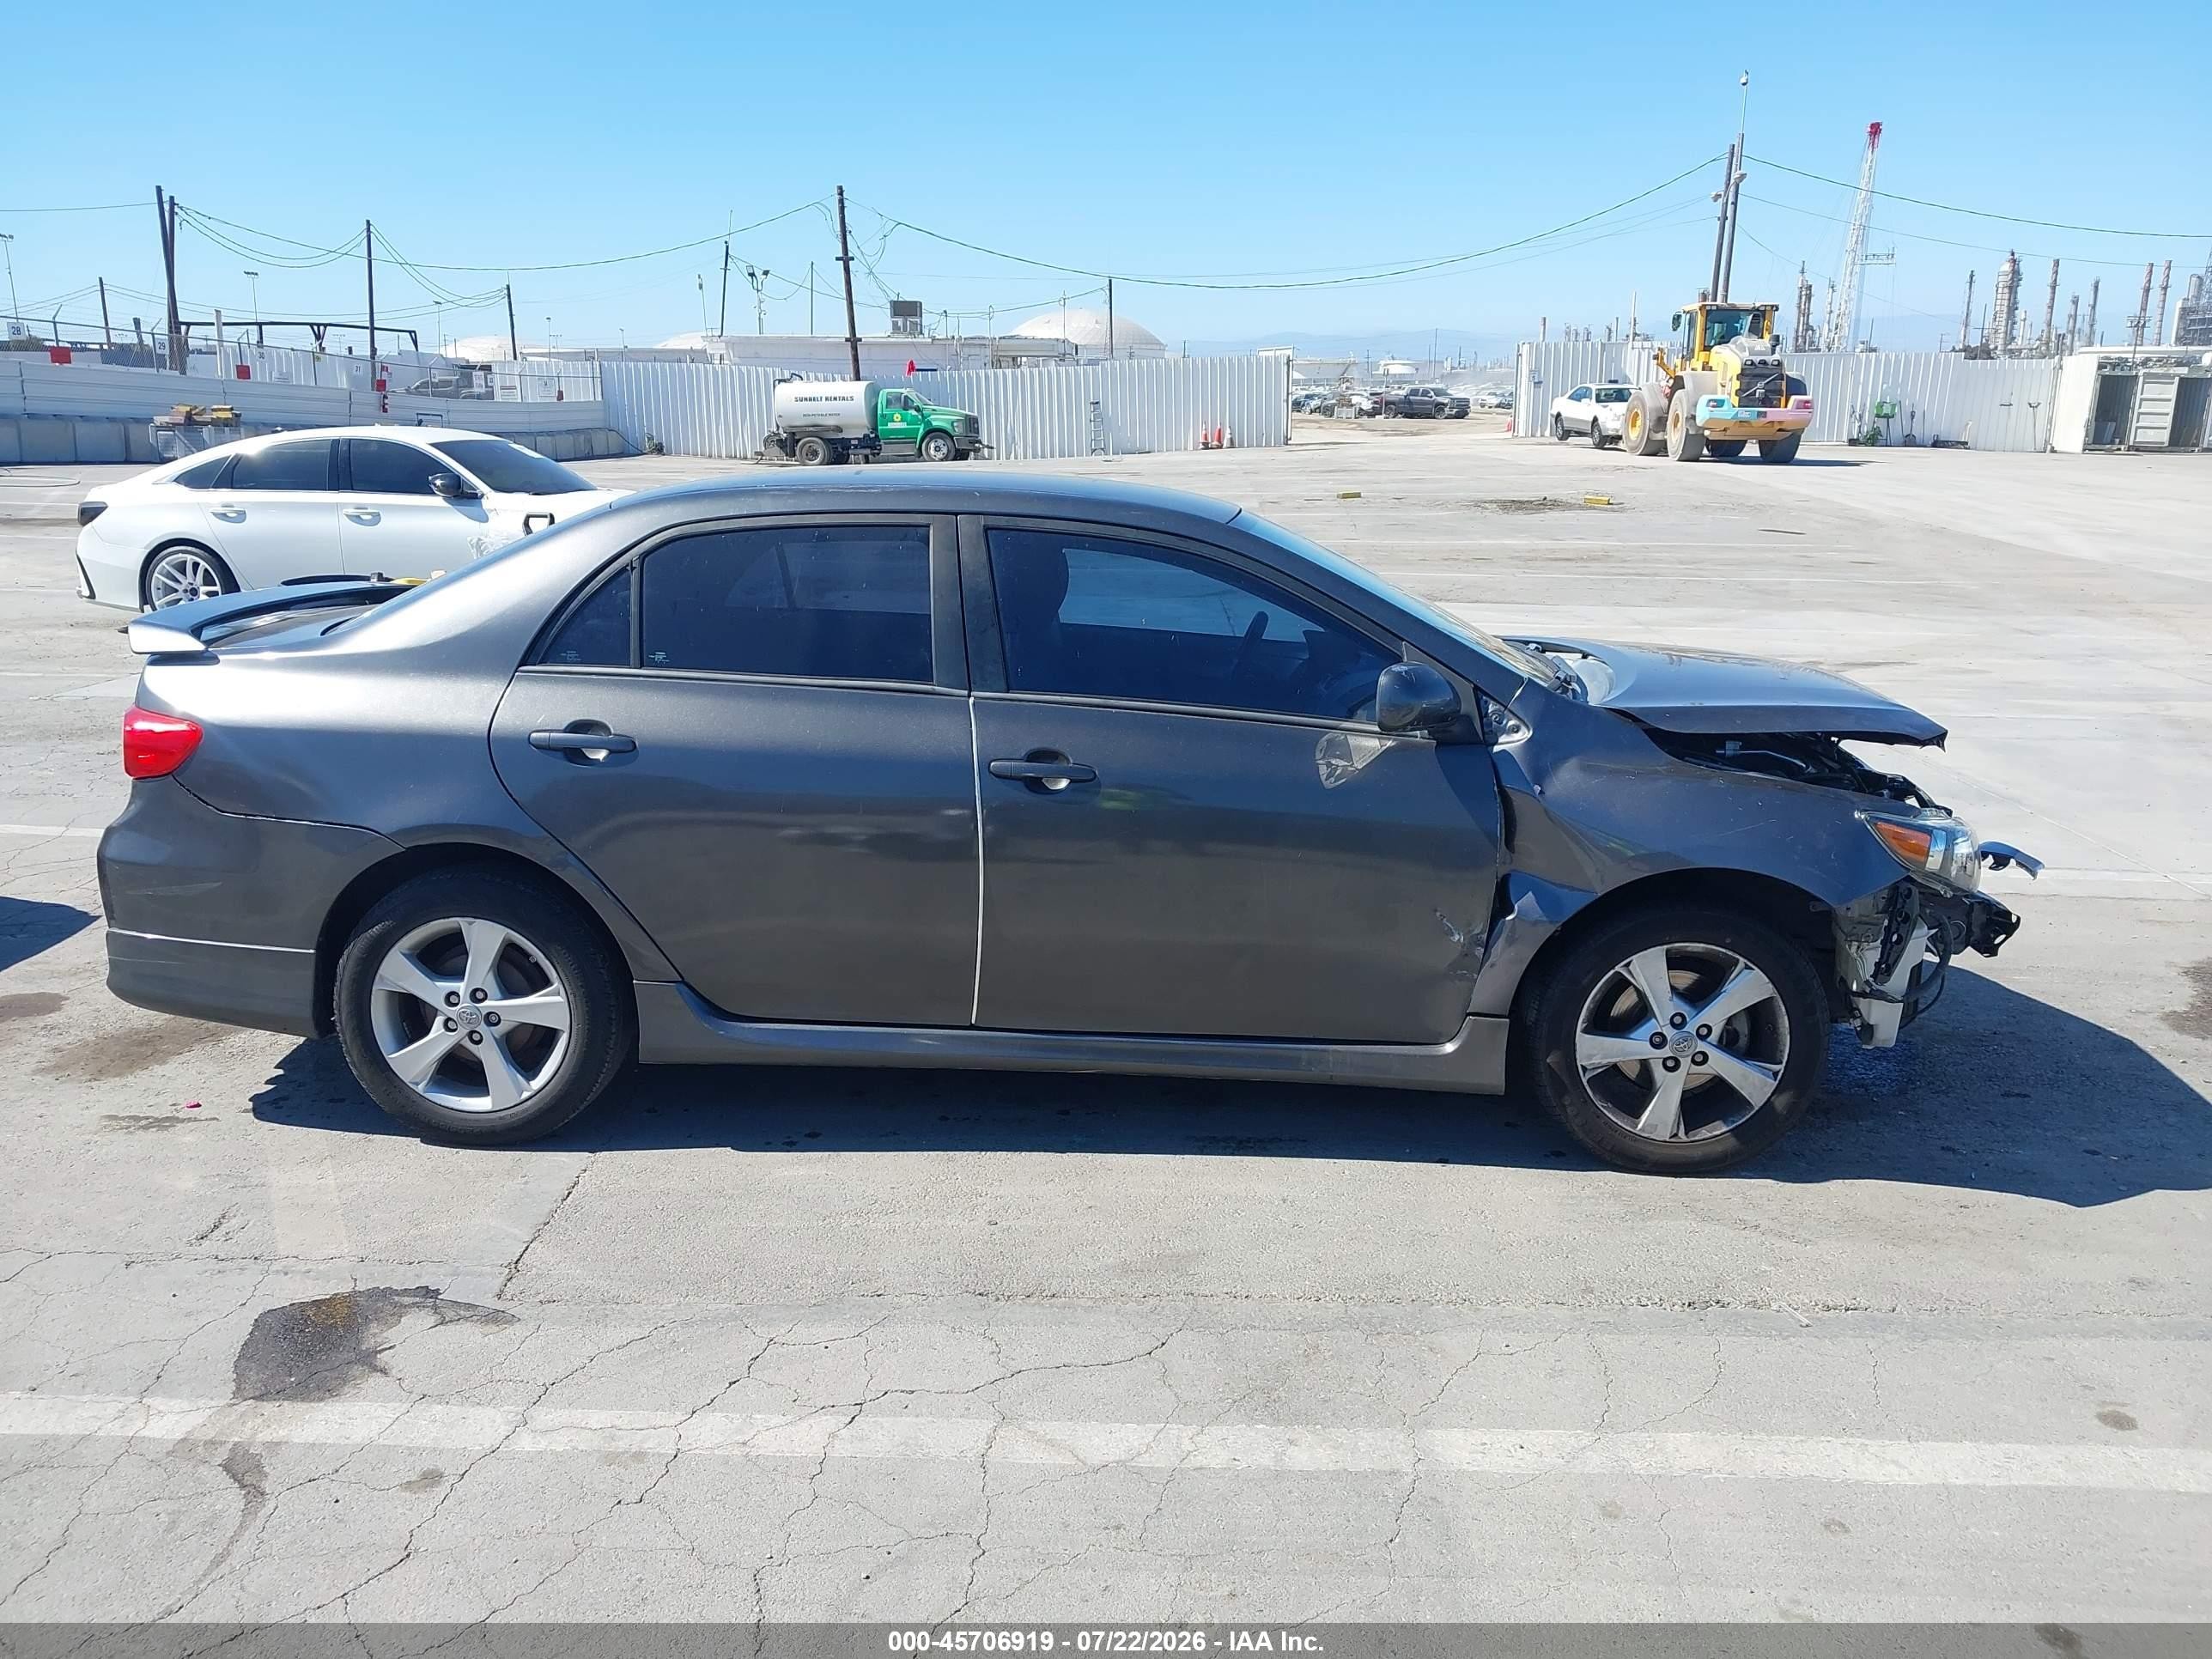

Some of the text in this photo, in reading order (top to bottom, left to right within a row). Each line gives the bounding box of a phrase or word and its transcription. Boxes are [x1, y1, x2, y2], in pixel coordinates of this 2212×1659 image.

[11, 325, 21, 336] 28
[157, 342, 166, 350] 29
[258, 351, 265, 360] 30
